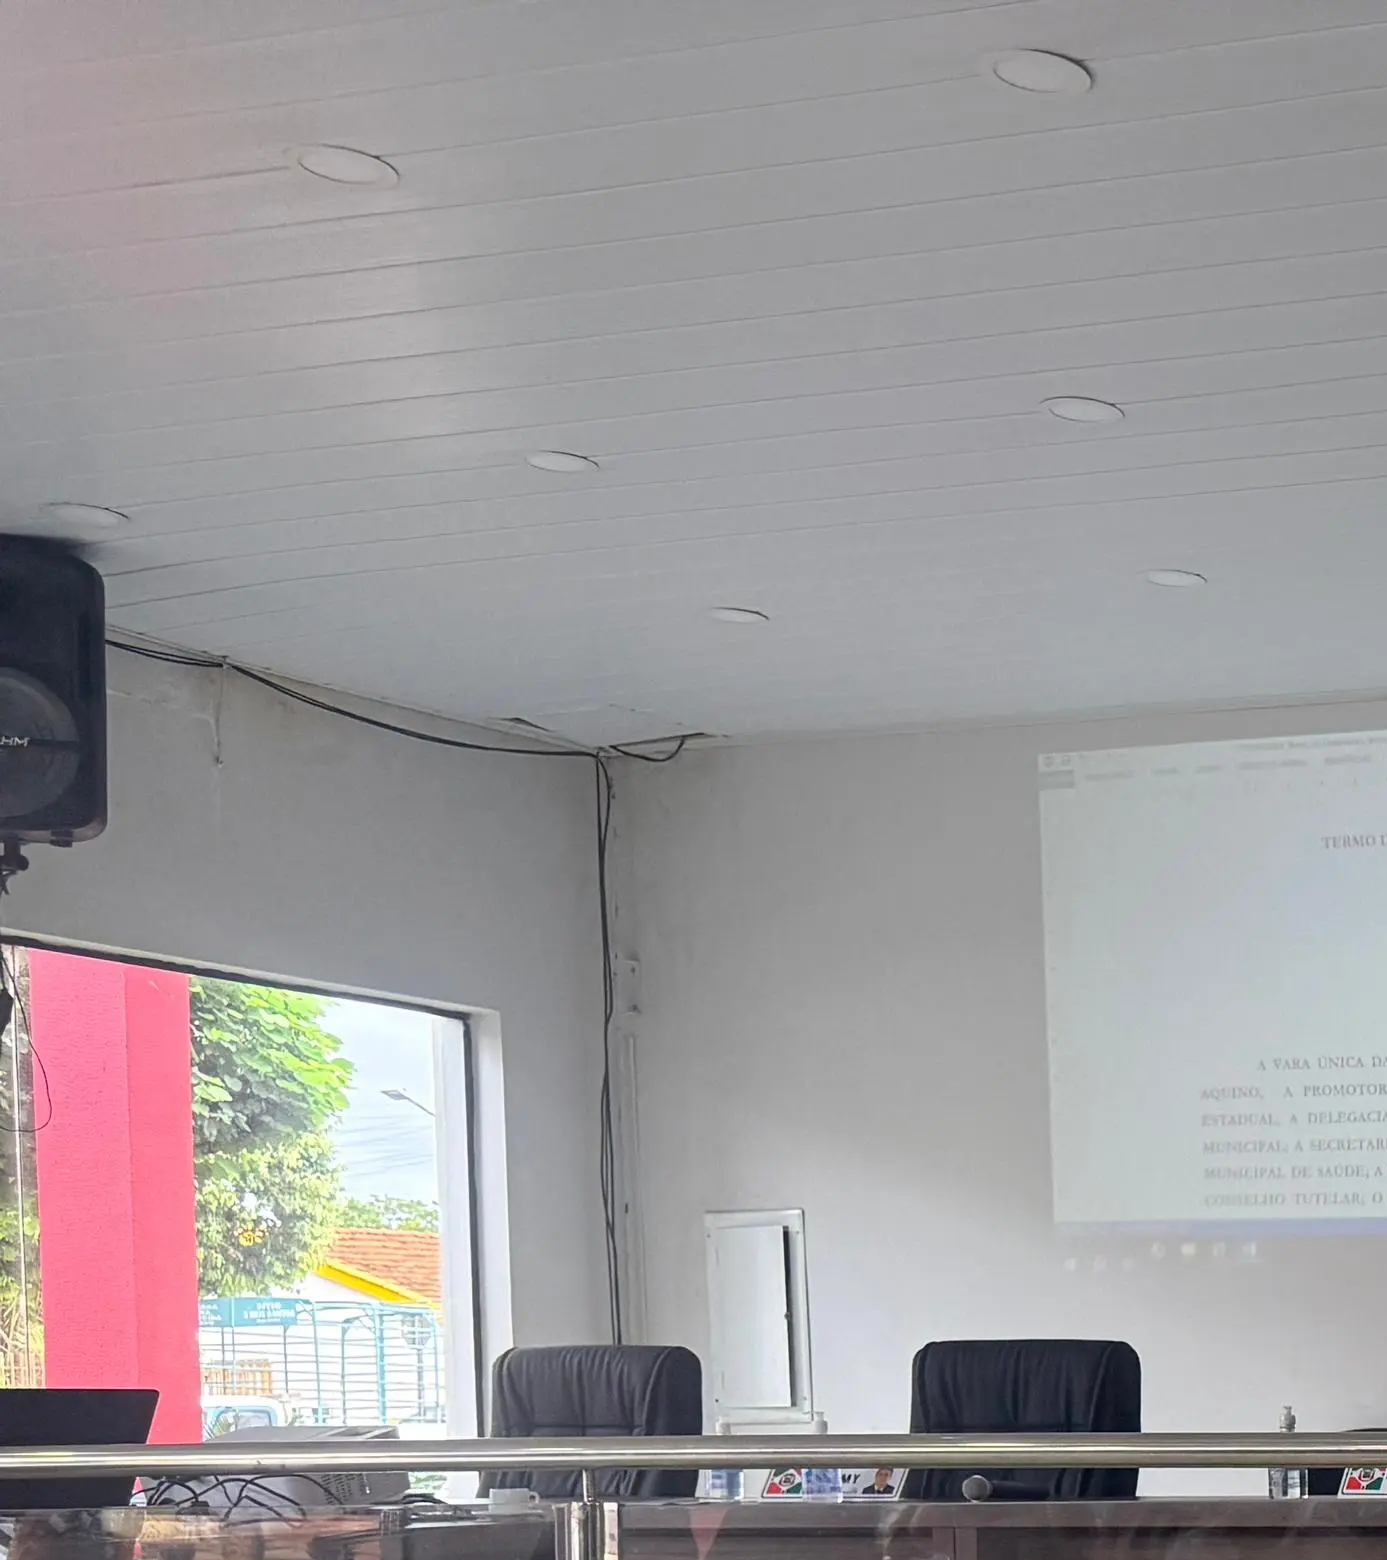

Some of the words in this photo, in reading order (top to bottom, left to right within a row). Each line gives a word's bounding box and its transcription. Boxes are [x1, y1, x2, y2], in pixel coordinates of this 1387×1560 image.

[1321, 836, 1376, 849] TERMO
[1257, 1059, 1266, 1071] A
[1273, 1057, 1311, 1071] VARA
[1317, 1054, 1364, 1069] ÚNICA
[1283, 1085, 1294, 1098] A
[1290, 1113, 1299, 1125] A
[1294, 1140, 1305, 1153] A
[1291, 1165, 1312, 1179] DE
[1374, 1164, 1384, 1177] A
[1372, 1191, 1383, 1204] O
